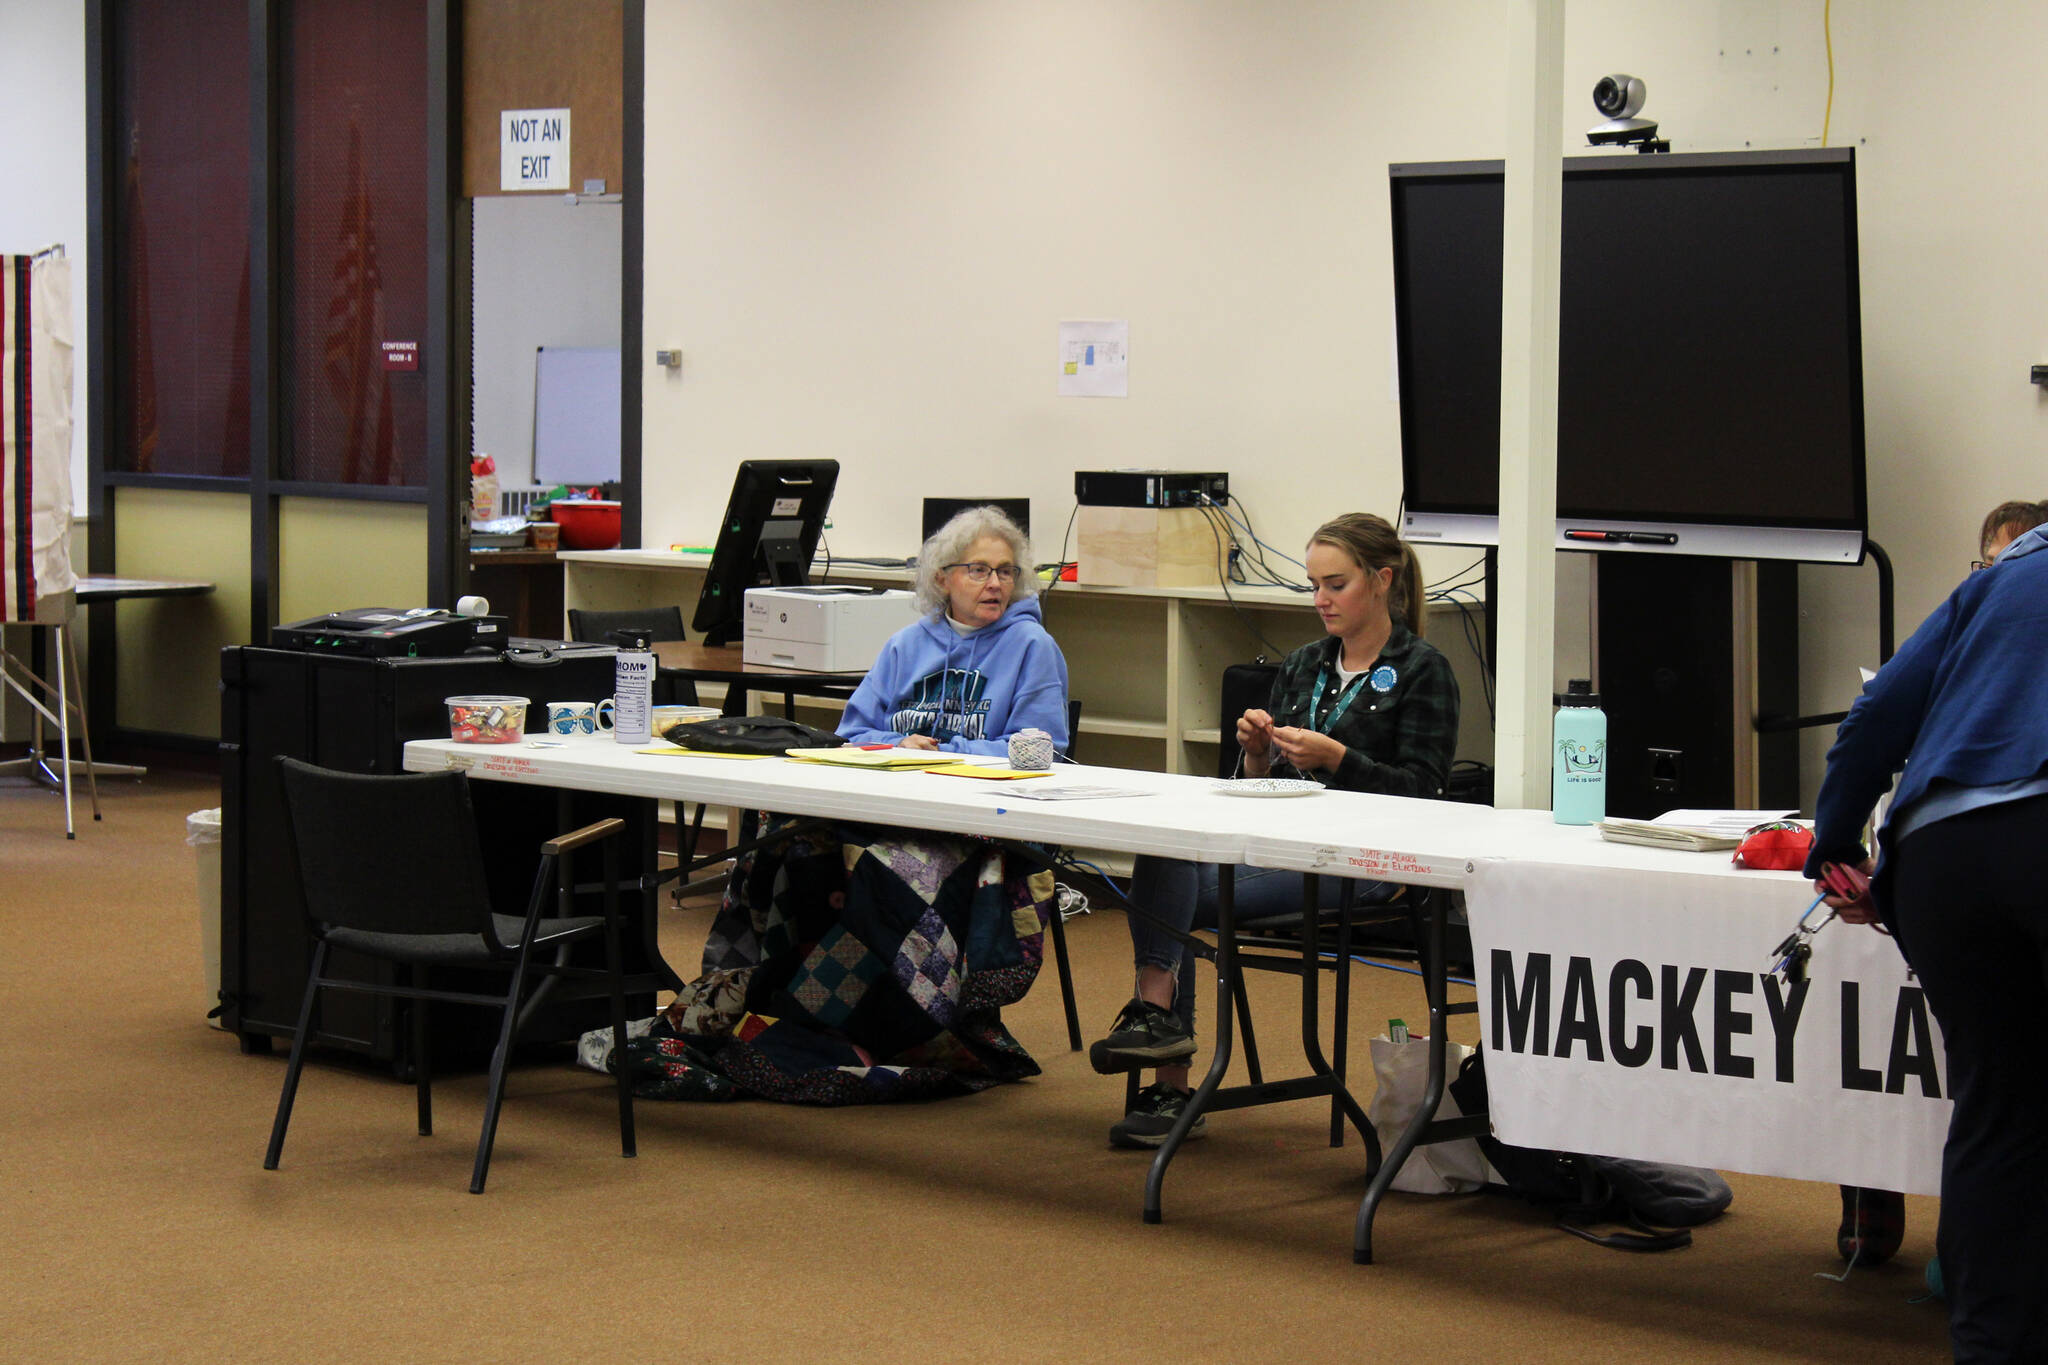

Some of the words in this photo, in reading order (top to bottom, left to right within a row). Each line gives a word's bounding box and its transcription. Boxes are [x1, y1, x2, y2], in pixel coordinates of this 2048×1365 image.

[511, 119, 538, 142] NOT
[541, 118, 561, 142] AN
[521, 155, 550, 179] EXIT
[382, 342, 417, 350] CONFERENCE
[1491, 948, 1811, 1084] MACKEY
[1841, 980, 1950, 1100] LA
